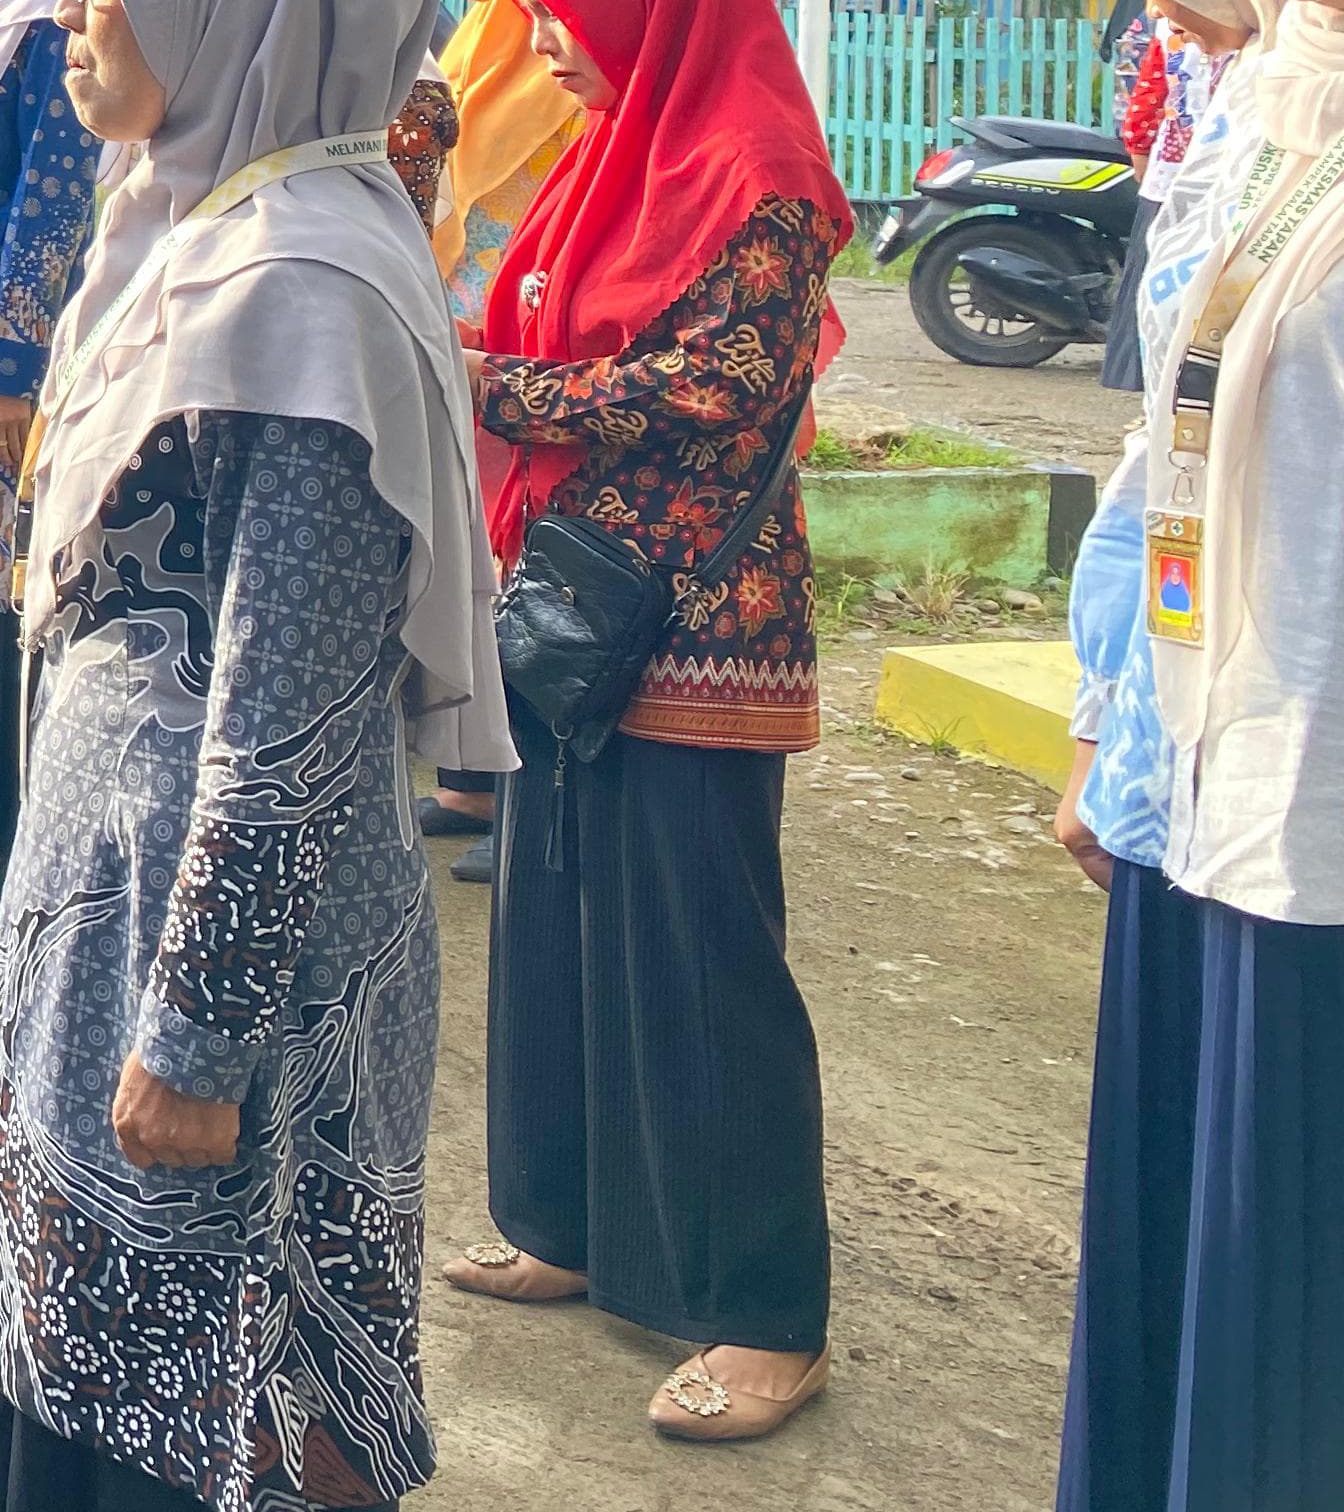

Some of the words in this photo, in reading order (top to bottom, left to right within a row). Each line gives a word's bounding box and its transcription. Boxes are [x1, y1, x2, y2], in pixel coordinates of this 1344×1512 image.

[1239, 183, 1259, 210] UPT
[1275, 189, 1305, 221] BALAI
[1247, 223, 1279, 257] TAPAN
[1258, 216, 1300, 264] TAPAN
